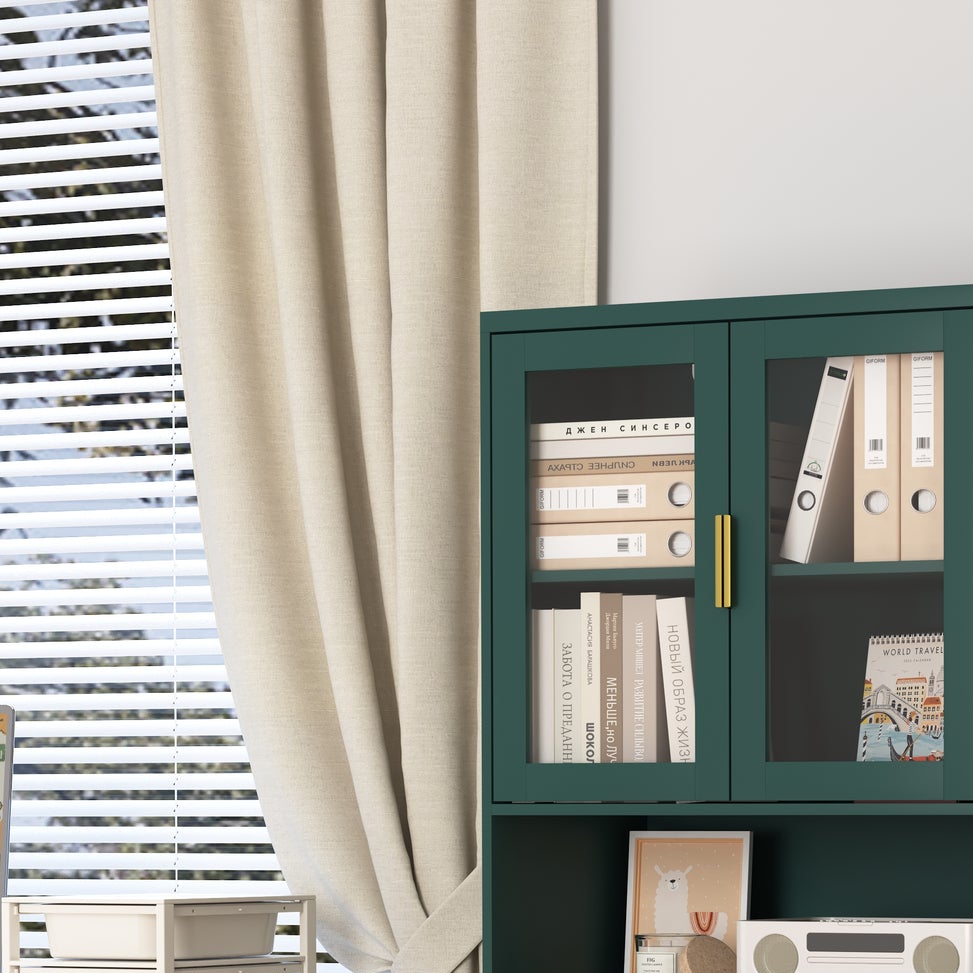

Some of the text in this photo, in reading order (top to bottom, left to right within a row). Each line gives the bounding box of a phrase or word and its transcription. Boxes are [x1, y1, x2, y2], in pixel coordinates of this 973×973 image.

[565, 422, 692, 435] ДЖЕН СИНСЕРО
[667, 624, 685, 674] НОВЫЙ
[883, 646, 943, 656] WORLD TRAVEL
[562, 643, 573, 687] ЗАБОТА
[563, 692, 572, 700] О
[672, 679, 687, 722] ОБРАЗ
